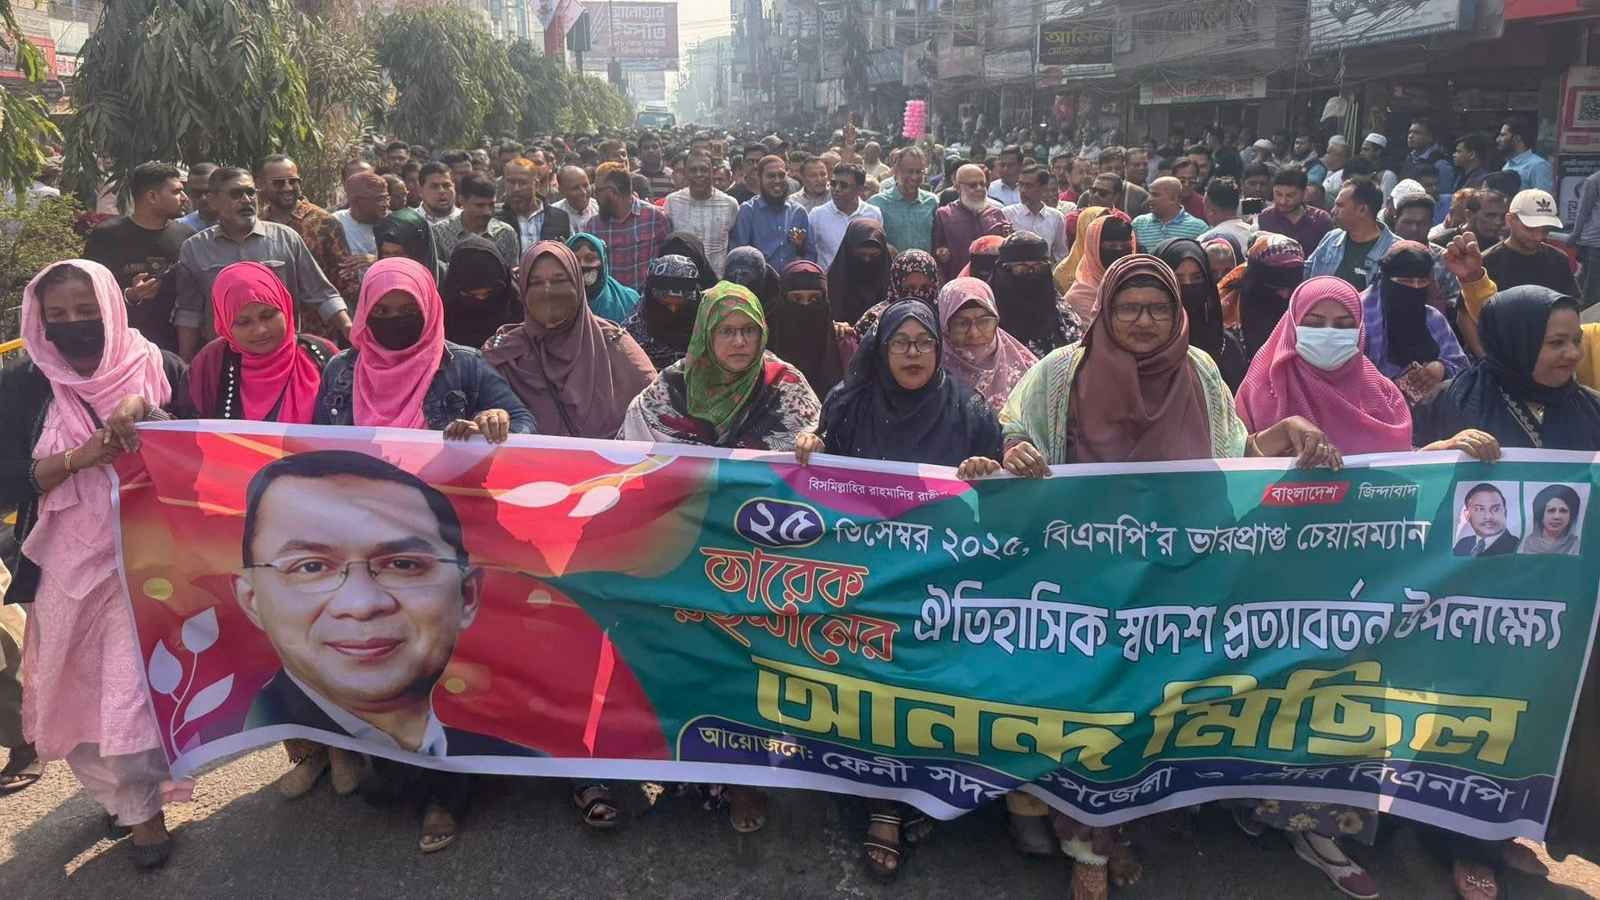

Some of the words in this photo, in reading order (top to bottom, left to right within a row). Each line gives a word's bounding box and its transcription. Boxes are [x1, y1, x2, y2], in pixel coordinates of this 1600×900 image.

[809, 476, 865, 496] বিসমিল্লাহির
[868, 486, 914, 502] রাহমানির
[1271, 484, 1340, 503] বাংলাদেশ
[1357, 480, 1421, 500] জিন্দাবাদ
[748, 503, 816, 543] ২৫
[1184, 522, 1291, 560] ভারপ্রাপ্ত
[1297, 516, 1432, 553] চেয়ারম্যান
[699, 546, 869, 616] তারেক
[913, 580, 1110, 658] ঐতিহাসিক
[1115, 604, 1218, 662] স্বদেশ
[1222, 578, 1395, 660] প্রত্যাবর্তন
[1393, 587, 1567, 651] উপলক্ষ্যে
[749, 654, 1136, 772] আনন্দ
[1141, 660, 1530, 767] মিছিল
[822, 751, 914, 783] ফেনী
[1038, 766, 1179, 808] পজেলা
